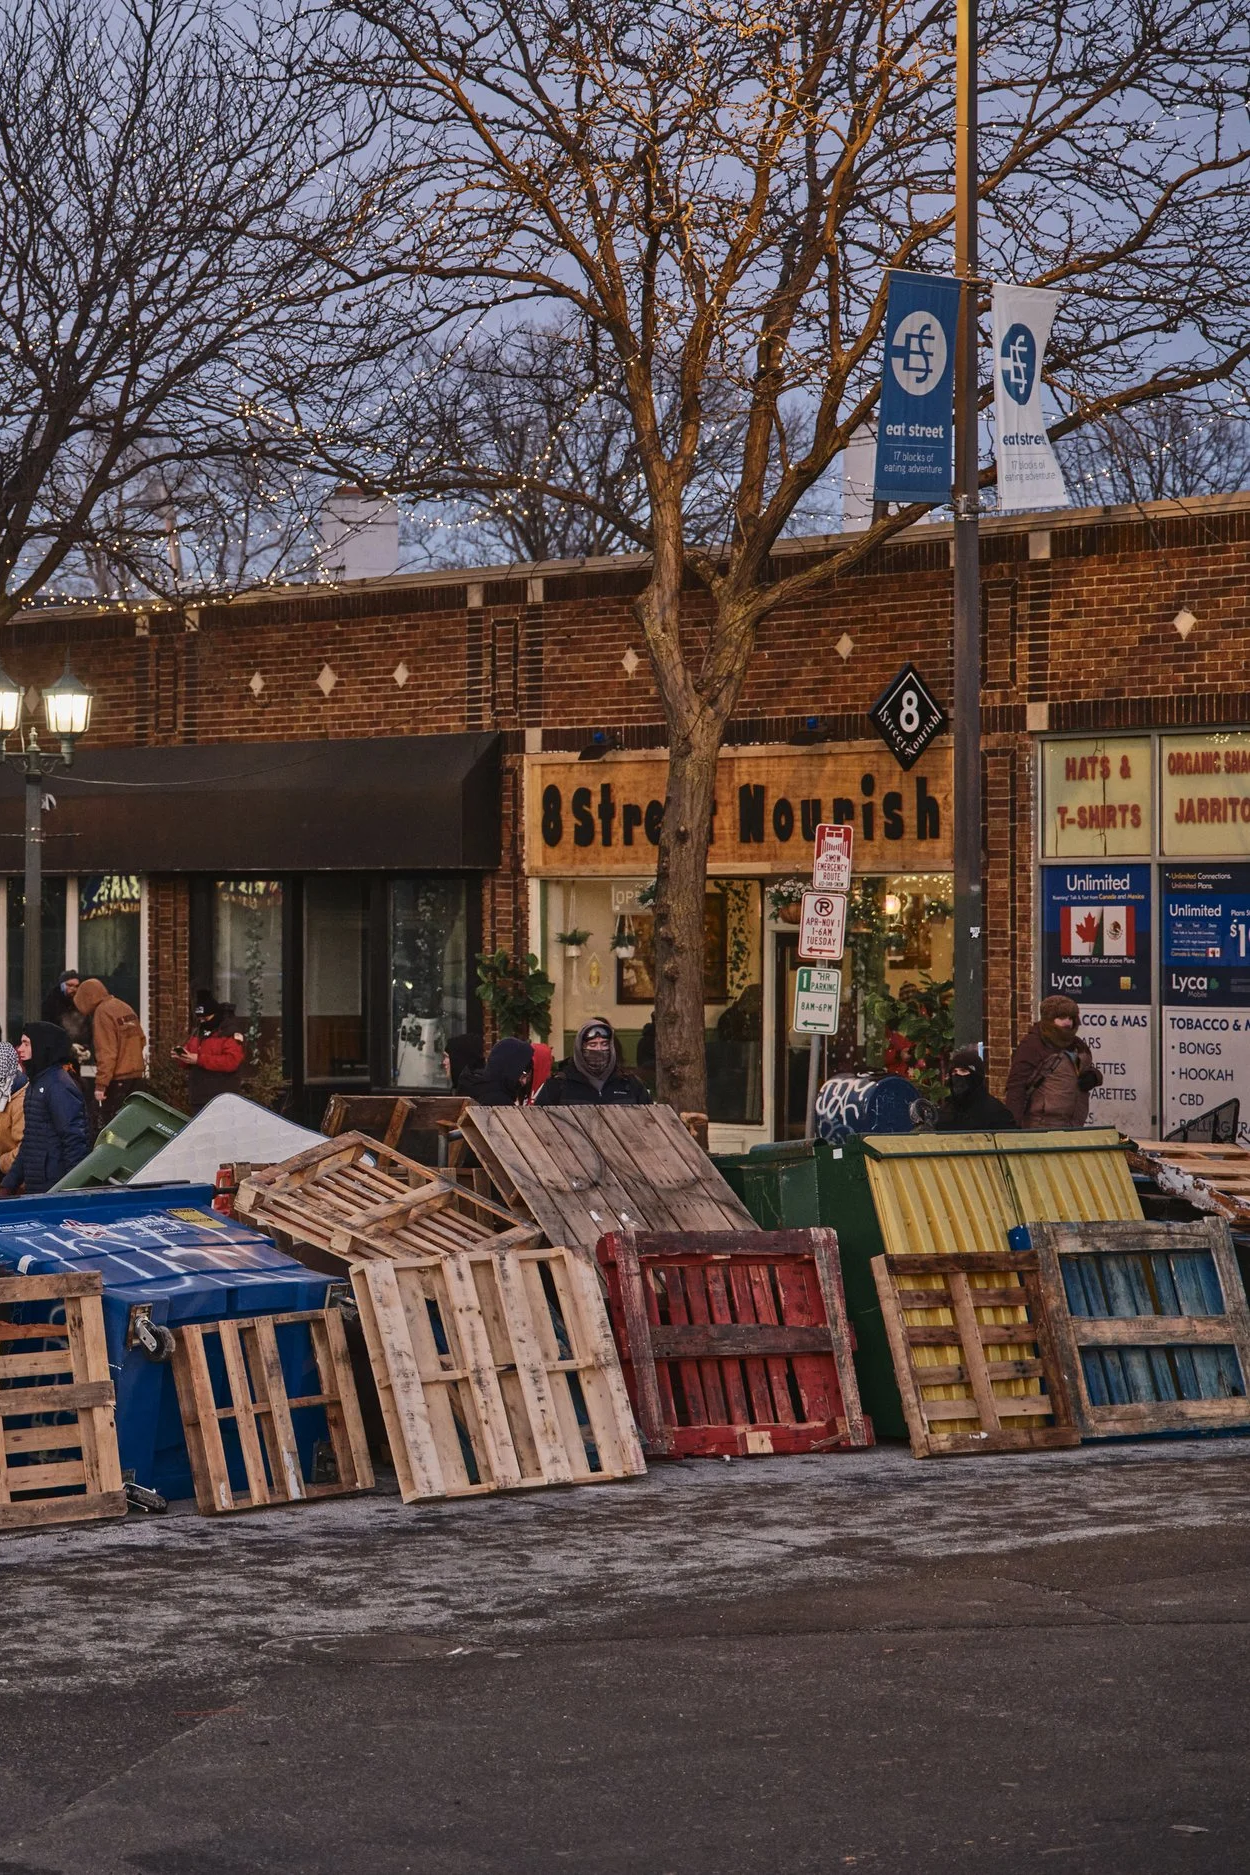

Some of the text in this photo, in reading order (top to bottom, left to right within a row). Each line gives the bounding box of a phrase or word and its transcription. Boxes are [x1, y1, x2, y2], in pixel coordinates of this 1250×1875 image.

[886, 422, 944, 438] eat street
[1003, 432, 1019, 446] eat
[893, 451, 934, 463] 17 blocks of
[884, 463, 943, 475] eating adventure
[900, 690, 920, 733] 8
[880, 710, 940, 757] Street Nourish
[1065, 755, 1131, 781] HATS &
[1167, 751, 1221, 776] ORGANIC
[542, 773, 940, 847] 8 Stre Nourish
[1057, 804, 1142, 830] T-SHIRTS
[825, 854, 841, 862] SNOW
[817, 863, 847, 872] EMERGENCY
[823, 872, 841, 881] ROUTE
[1067, 873, 1130, 892] Unlimited
[1171, 872, 1197, 880] Unlimited
[1169, 904, 1222, 917] Unlimited
[812, 927, 832, 937] 1-6AM
[807, 936, 837, 946] TUESDAY
[803, 972, 808, 989] 1
[811, 982, 837, 992] PARKING
[1051, 972, 1082, 990] Lyca
[1172, 973, 1207, 992] Lyca
[1188, 990, 1207, 998] Mobile
[801, 1001, 833, 1012] 8AM-6PM
[1110, 1015, 1118, 1027] &
[1121, 1015, 1148, 1028] MAS
[1169, 1017, 1229, 1031] TOBACCO
[1232, 1019, 1242, 1031] &
[1179, 1042, 1222, 1056] BONGS
[1179, 1067, 1234, 1082] HOOKAH
[1091, 1088, 1137, 1101] ARETTES
[1179, 1093, 1204, 1106] CBD
